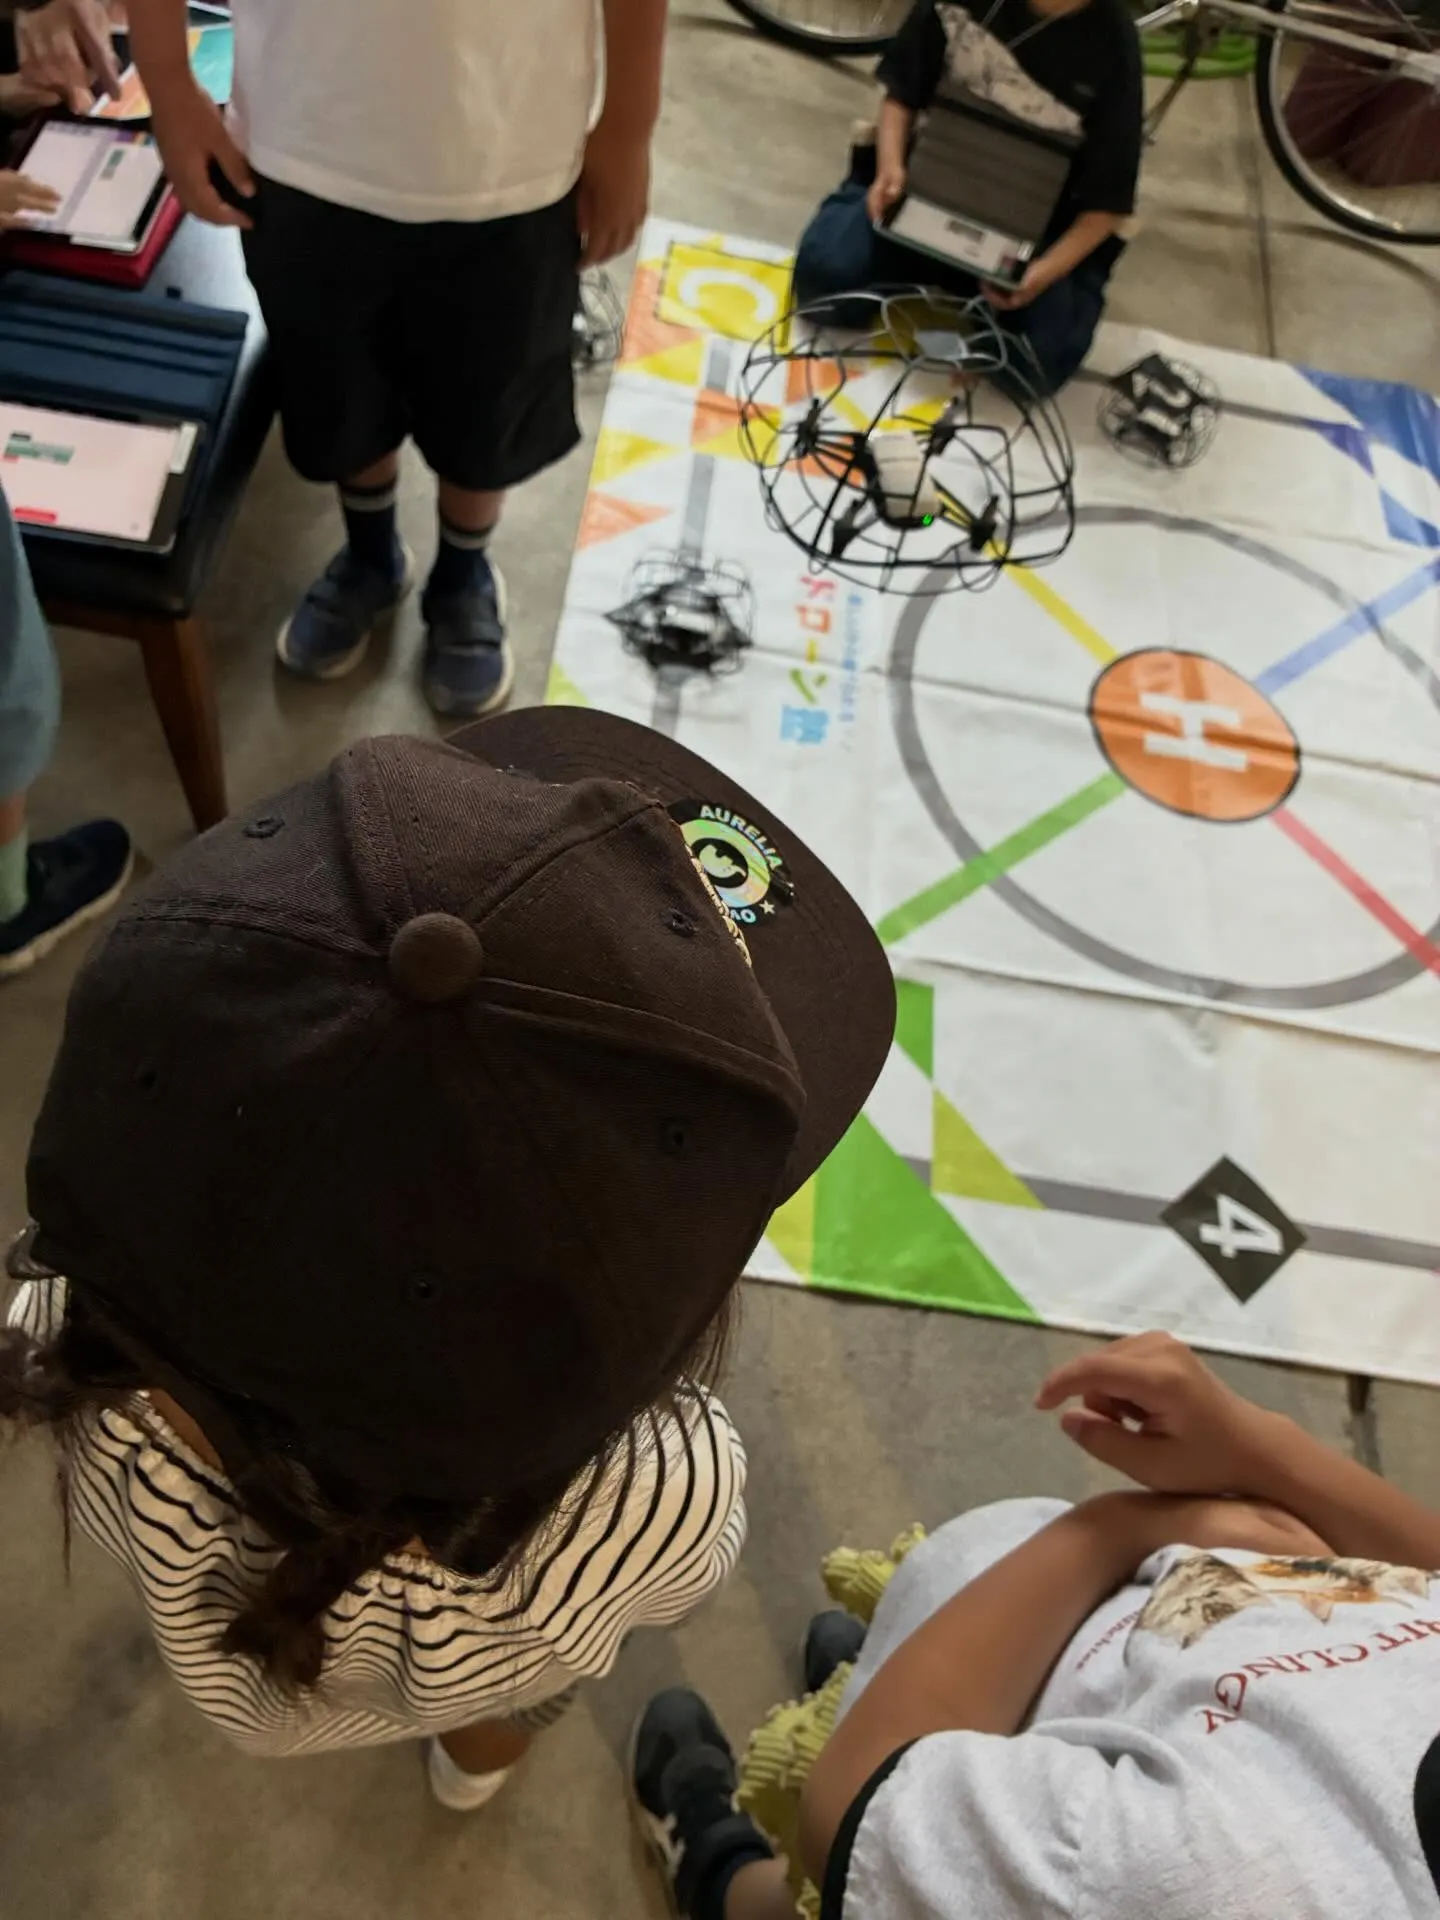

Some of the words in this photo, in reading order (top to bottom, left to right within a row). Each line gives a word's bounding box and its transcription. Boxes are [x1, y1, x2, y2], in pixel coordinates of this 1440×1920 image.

[1138, 691, 1248, 773] H
[700, 804, 784, 871] AURELIA
[1198, 1193, 1284, 1259] 4
[1196, 1642, 1369, 1735] CLINGY
